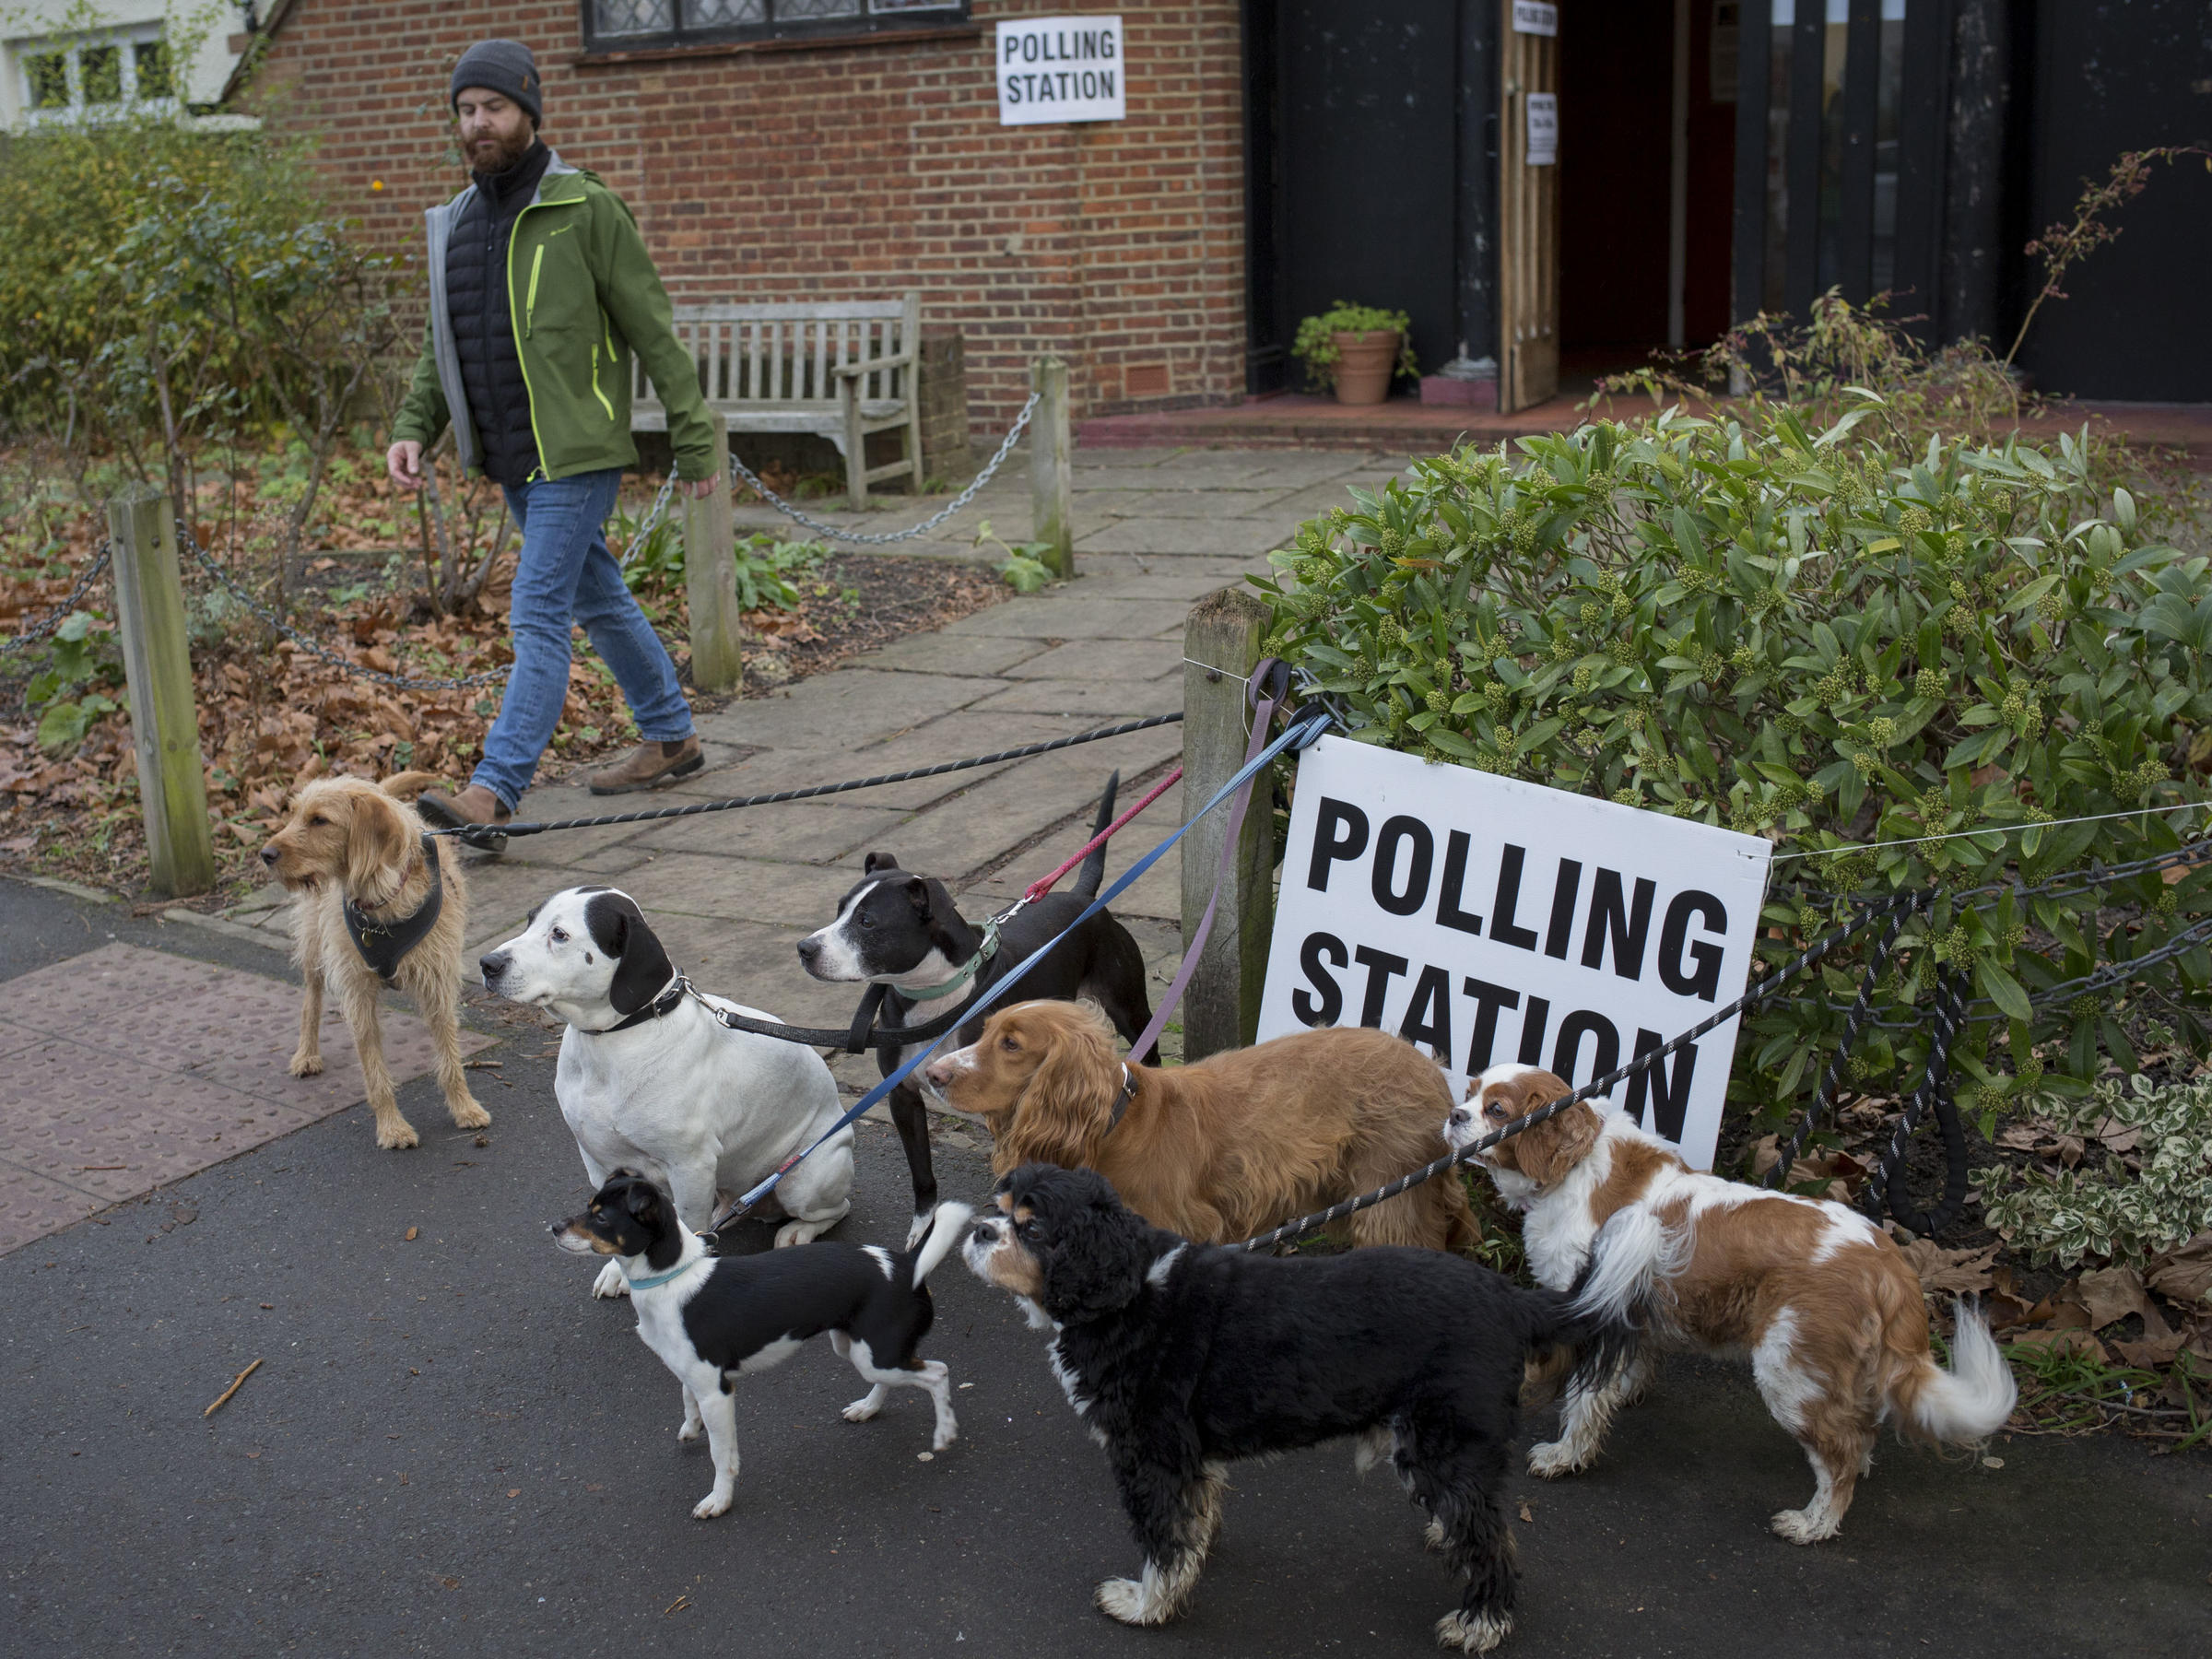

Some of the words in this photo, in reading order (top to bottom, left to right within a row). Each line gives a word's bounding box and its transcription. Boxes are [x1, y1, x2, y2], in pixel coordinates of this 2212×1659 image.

[1005, 30, 1114, 64] POLLING
[1006, 70, 1114, 103] STATION
[1307, 796, 1728, 1003] POLLING
[1292, 932, 1700, 1145] STATION
